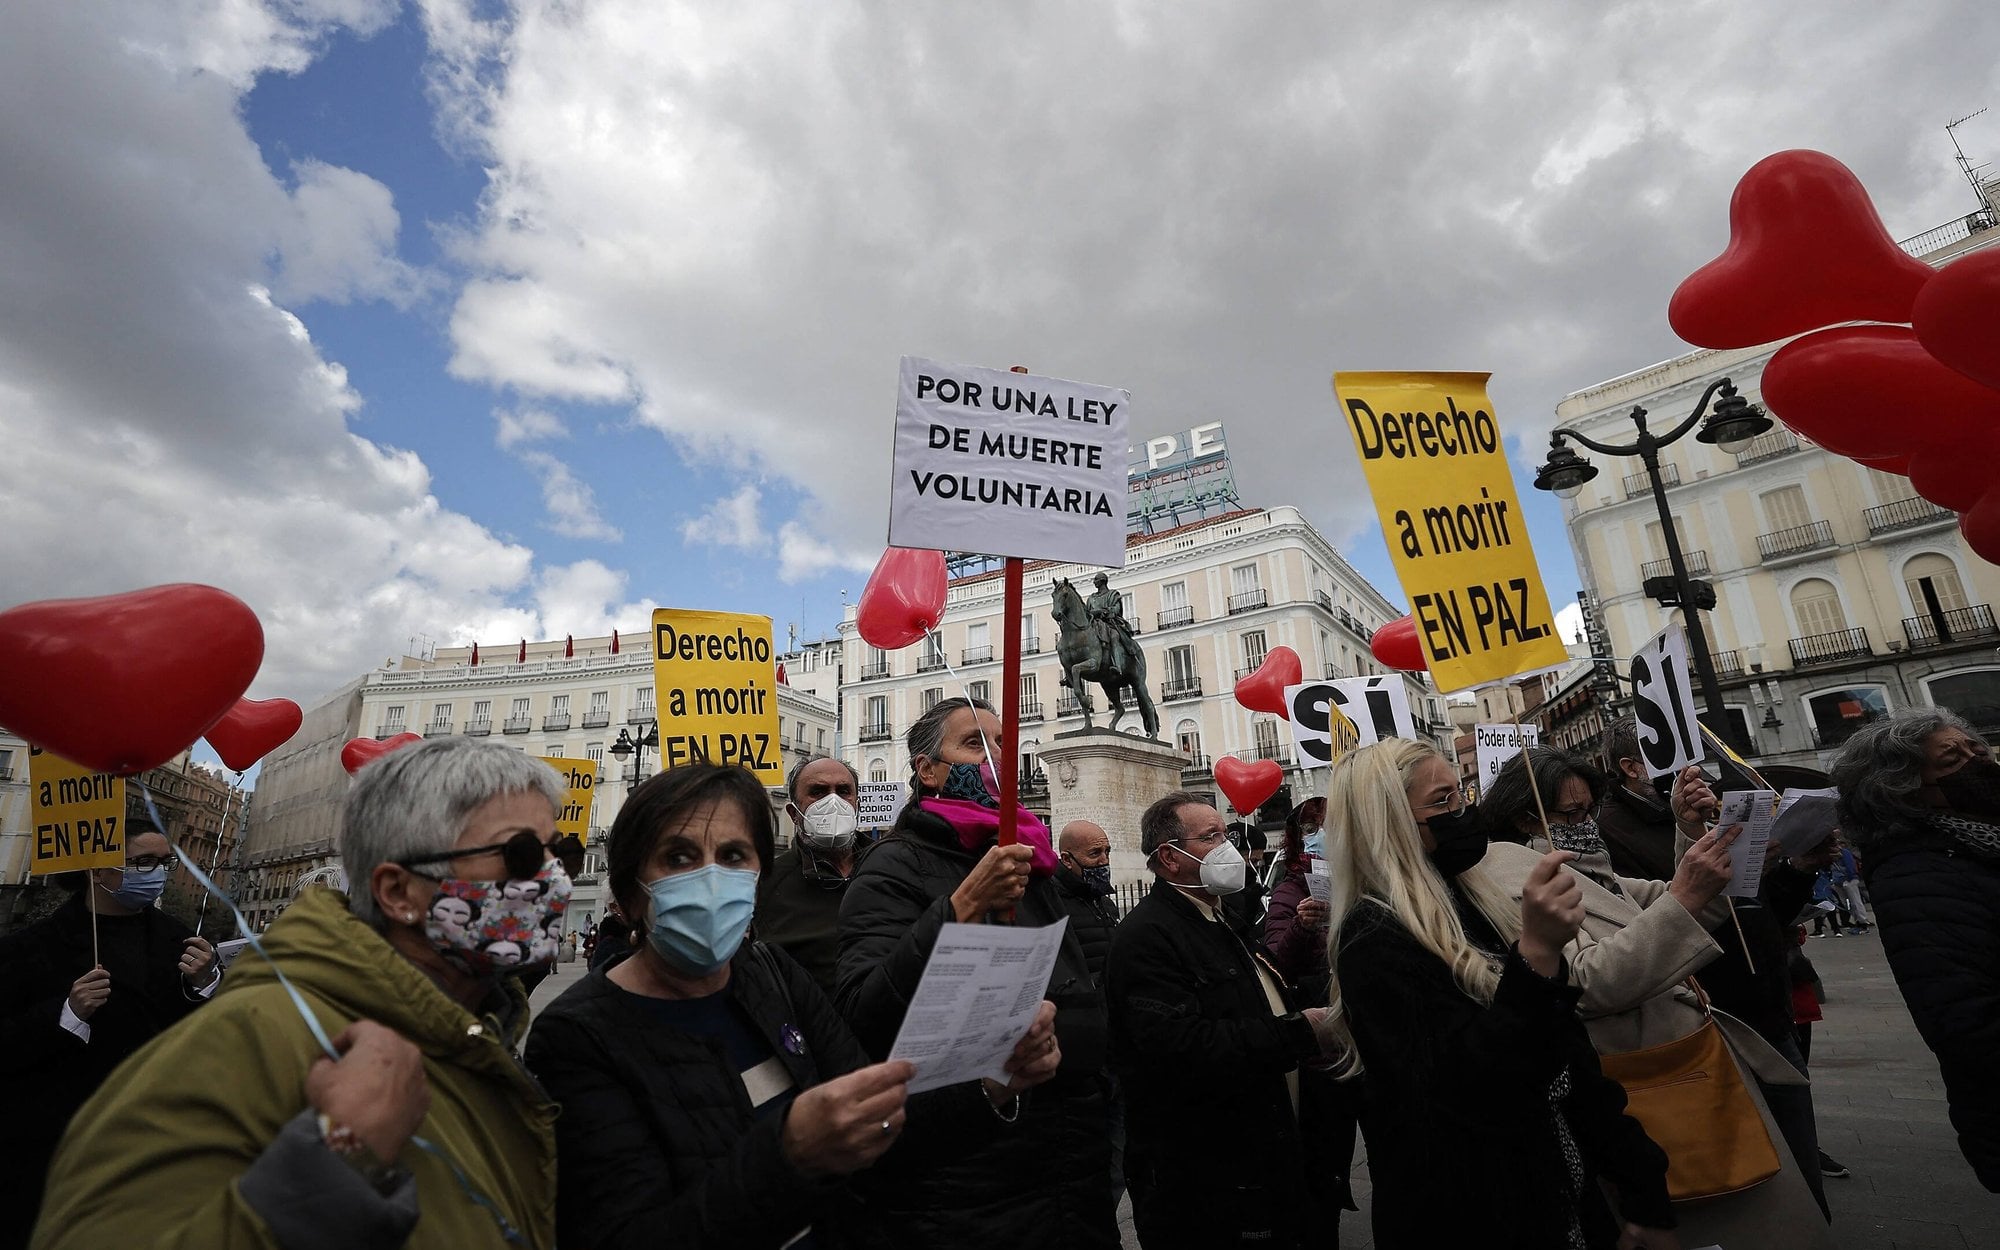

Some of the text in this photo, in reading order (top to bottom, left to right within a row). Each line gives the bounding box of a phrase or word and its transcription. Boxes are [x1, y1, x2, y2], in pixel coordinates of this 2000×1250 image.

[917, 375, 1118, 426] POR UNA LEY
[928, 424, 1103, 470] DE MUERTE
[1345, 397, 1498, 460] Derecho
[910, 469, 1113, 518] VOLUNTARIA
[1395, 486, 1512, 559] a morir
[1413, 577, 1552, 662] EN PAZ.
[1578, 598, 1604, 655] HOTEL
[656, 623, 770, 662] Derecho
[669, 680, 766, 716] a morir
[1293, 677, 1399, 762] SÍ
[1630, 633, 1696, 770] SÍ
[666, 734, 778, 770] EN PAZ.
[1477, 728, 1506, 747] Poder
[1490, 756, 1499, 775] el
[40, 774, 116, 807] a morir
[858, 784, 899, 793] RETIRADA
[879, 794, 896, 802] 143
[37, 816, 121, 860] EN PAZ.
[860, 814, 892, 823] PENAL!
